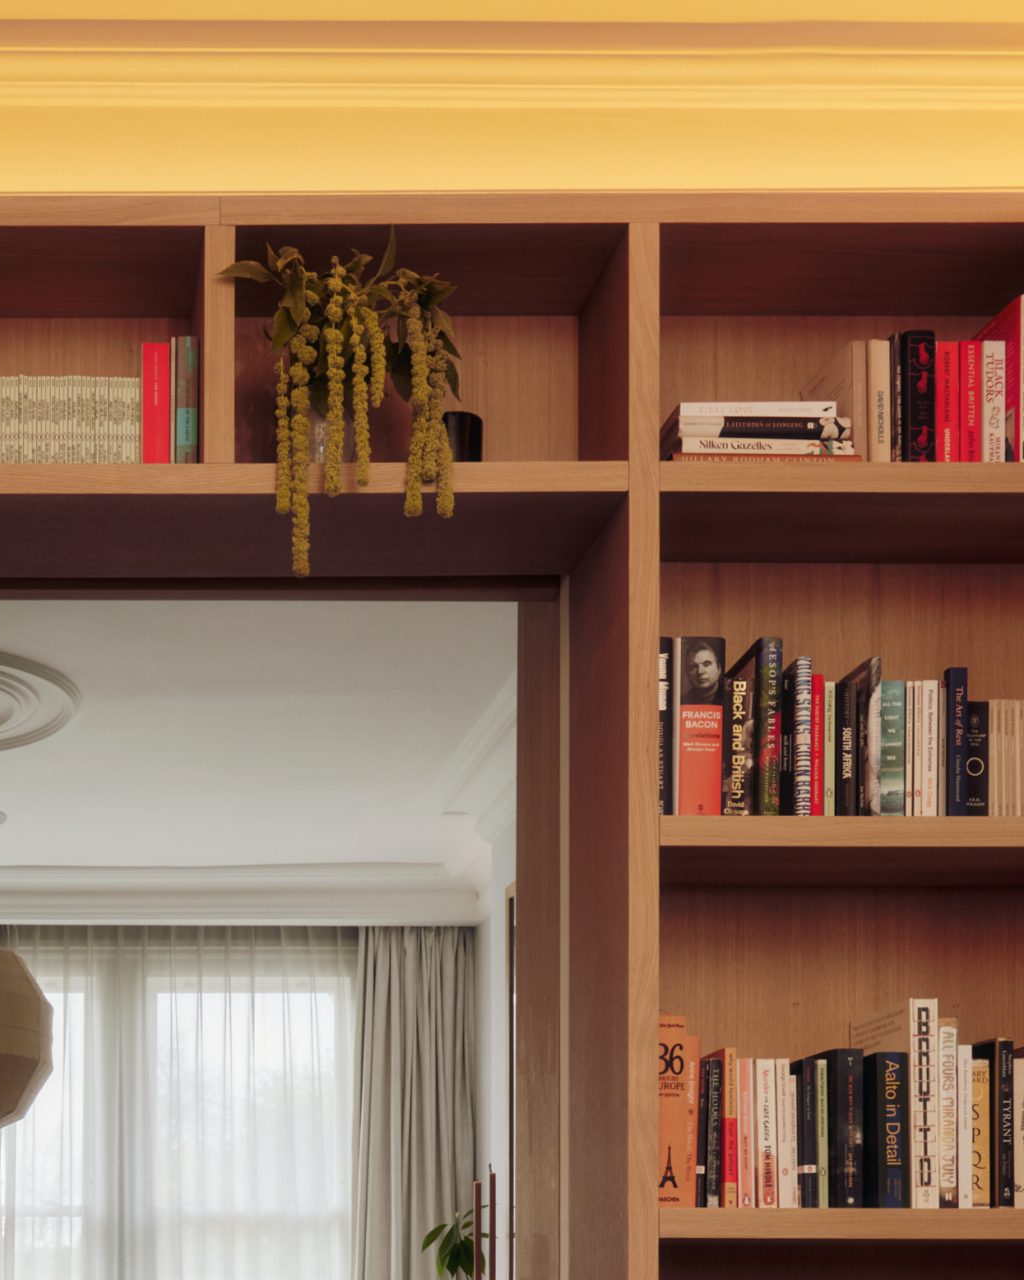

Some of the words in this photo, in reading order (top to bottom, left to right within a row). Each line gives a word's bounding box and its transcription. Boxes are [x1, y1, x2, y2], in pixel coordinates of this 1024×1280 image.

[986, 352, 994, 404] TUDORS
[994, 359, 1004, 398] BLACK
[699, 440, 729, 450] Silken
[730, 441, 773, 451] Gazelles
[732, 681, 746, 720] Black
[956, 687, 964, 702] The
[686, 720, 718, 728] BACON
[767, 701, 776, 750] FABLES
[956, 704, 964, 718] Art
[732, 724, 746, 751] and
[842, 728, 852, 750] SOUTH
[955, 728, 963, 746] Rest
[731, 754, 745, 799] British
[842, 752, 852, 779] AFRICA
[943, 1032, 954, 1051] ALL
[660, 1044, 684, 1075] 36
[943, 1054, 954, 1092] FOURS
[886, 1060, 901, 1100] Aalto
[711, 1091, 719, 1127] HOURS
[886, 1104, 901, 1118] in
[943, 1097, 954, 1150] MIRANDA
[1002, 1098, 1012, 1145] TYRANT
[886, 1122, 902, 1165] Detail
[943, 1154, 954, 1184] JULY
